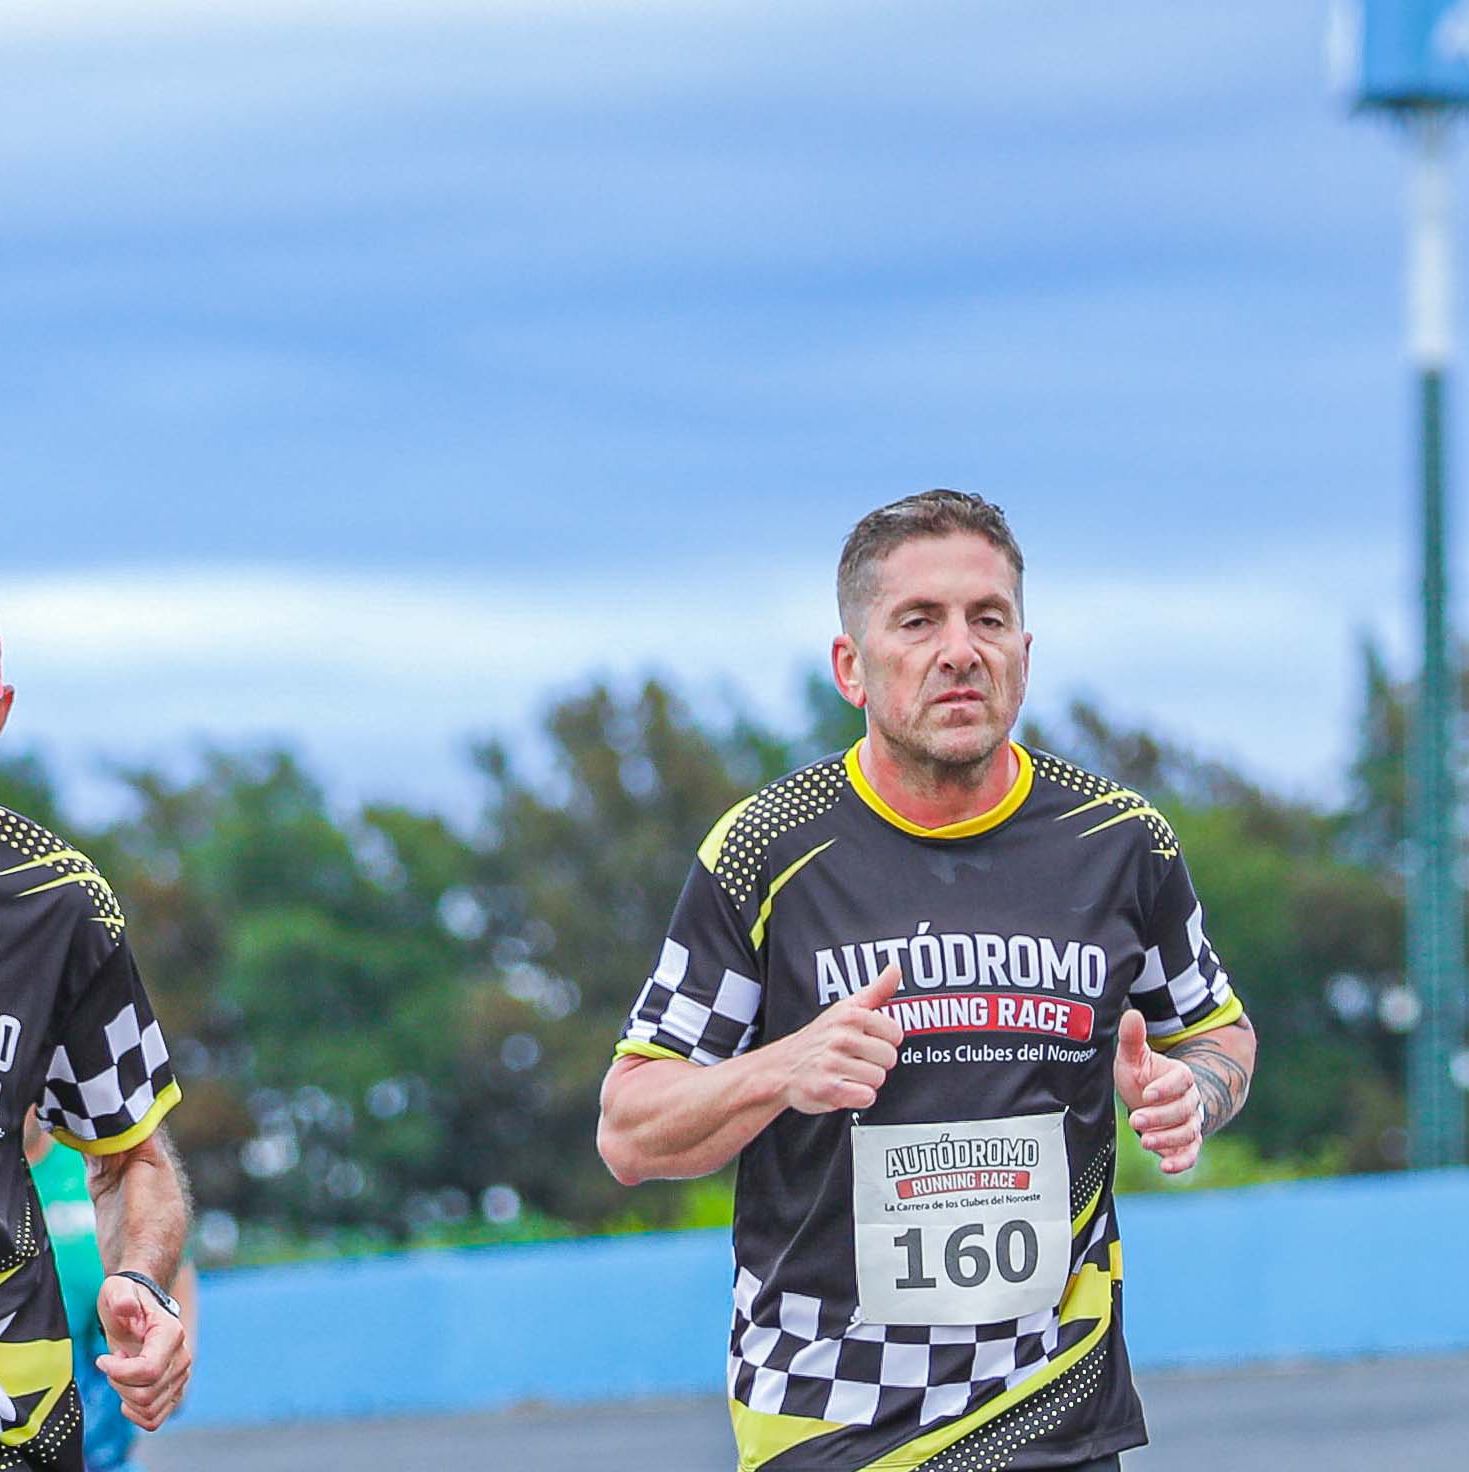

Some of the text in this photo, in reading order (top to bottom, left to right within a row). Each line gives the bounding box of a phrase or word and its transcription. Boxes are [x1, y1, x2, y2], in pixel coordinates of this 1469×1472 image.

[815, 921, 1107, 1005] AUTÓDROMO
[874, 997, 1071, 1034] UNNING RACE
[901, 1046, 922, 1064] de
[926, 1045, 951, 1063] los
[955, 1045, 1013, 1063] Clubes
[1017, 1043, 1044, 1062] del
[885, 1132, 1040, 1178] AUTÓDROMO
[911, 1172, 1017, 1196] RUNNING RACE
[884, 1202, 895, 1212] La
[897, 1202, 930, 1212] Carrera
[932, 1200, 944, 1210] de
[945, 1199, 959, 1208] los
[893, 1219, 1039, 1290] 160
